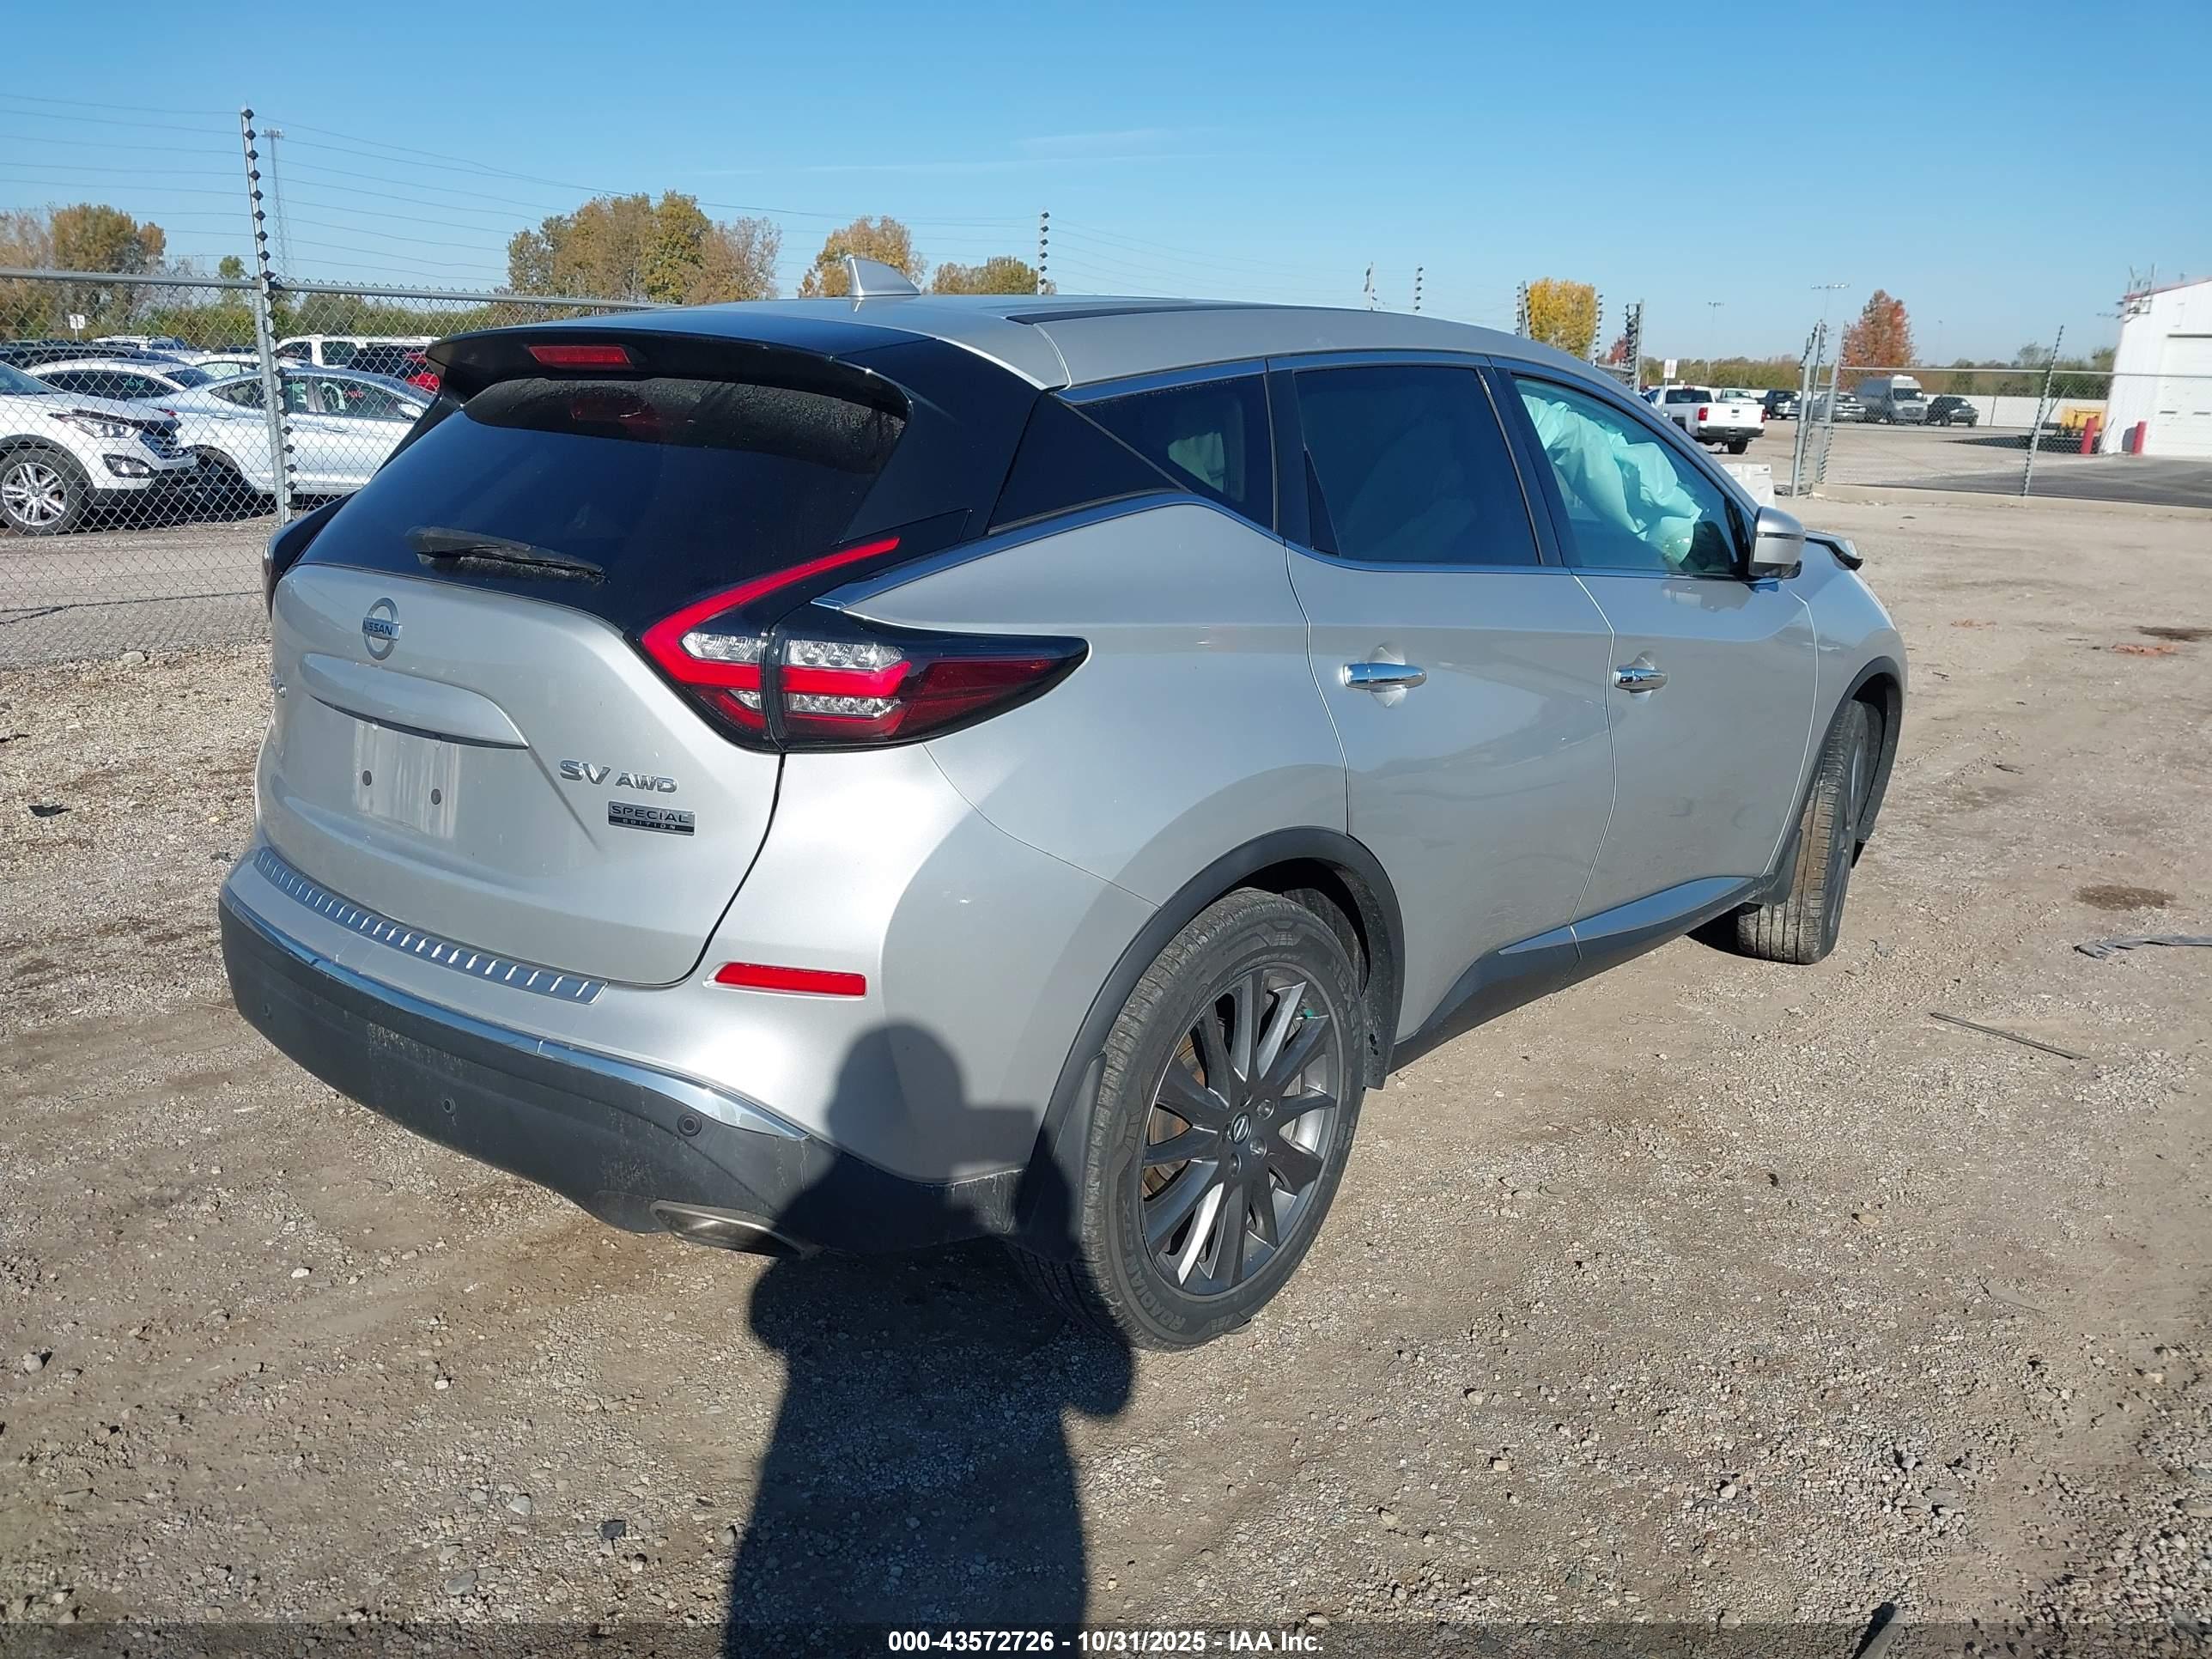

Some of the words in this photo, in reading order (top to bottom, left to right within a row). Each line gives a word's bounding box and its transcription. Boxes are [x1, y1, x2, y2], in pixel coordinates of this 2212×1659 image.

[362, 620, 393, 636] NISSAN
[559, 759, 612, 785] SV
[614, 772, 678, 793] AWD
[611, 805, 690, 824] SPECIAL
[622, 817, 677, 830] EDITION
[1125, 1254, 1187, 1332] ROADIAN
